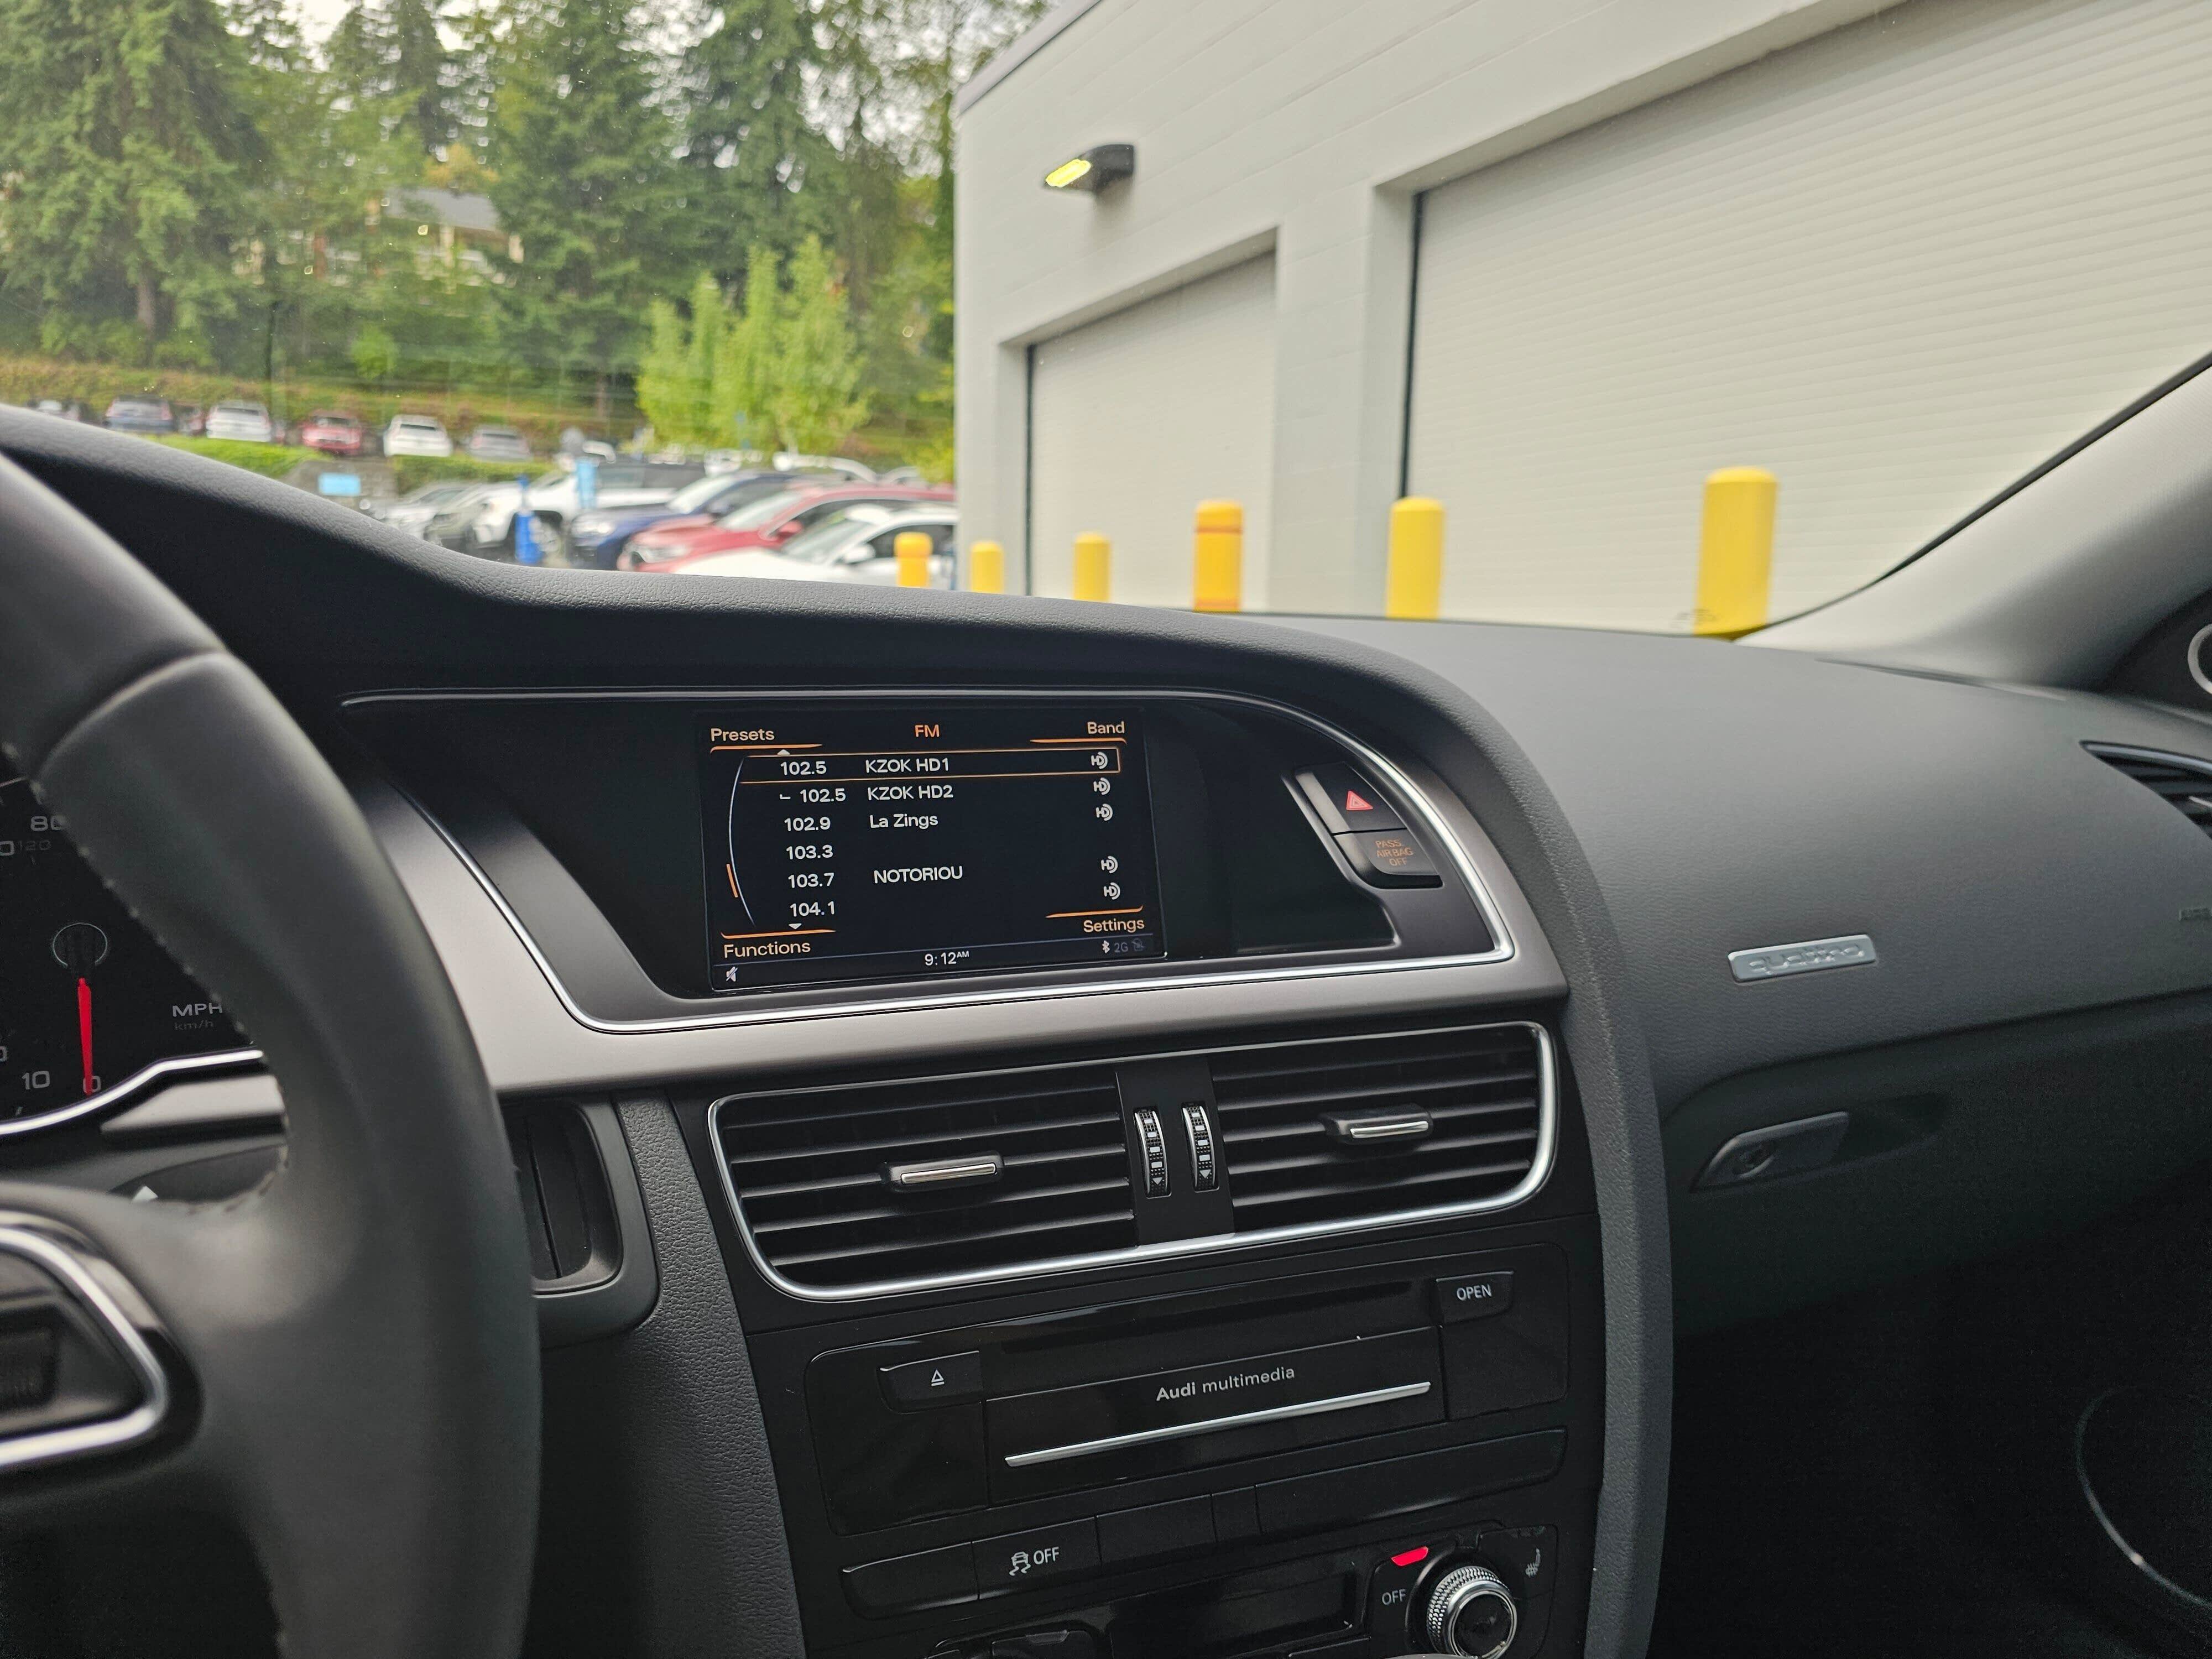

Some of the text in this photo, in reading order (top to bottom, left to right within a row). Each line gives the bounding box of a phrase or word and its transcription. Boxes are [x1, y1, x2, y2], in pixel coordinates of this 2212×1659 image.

[711, 728, 775, 742] Presets
[915, 724, 940, 738] FM
[1087, 721, 1125, 734] Band
[780, 758, 948, 775] 102.5 KZOK HD1
[800, 784, 954, 803] 102.5 KZOK HD2
[784, 813, 938, 832] 102.9 La Zings
[786, 844, 833, 860] 103.3
[1389, 857, 1407, 867] OFF
[788, 865, 963, 889] 103.7 NOTORIOU
[790, 901, 834, 917] 104.1
[1083, 918, 1145, 933] Settings
[723, 941, 811, 958] Functions
[1114, 941, 1129, 953] 2G
[172, 1003, 223, 1017] MPH
[22, 1071, 50, 1090] 10
[1456, 1284, 1492, 1301] OPEN
[1156, 1366, 1295, 1401] Audi multimedia
[1033, 1546, 1060, 1565] OFF
[1381, 1589, 1407, 1606] OFF
